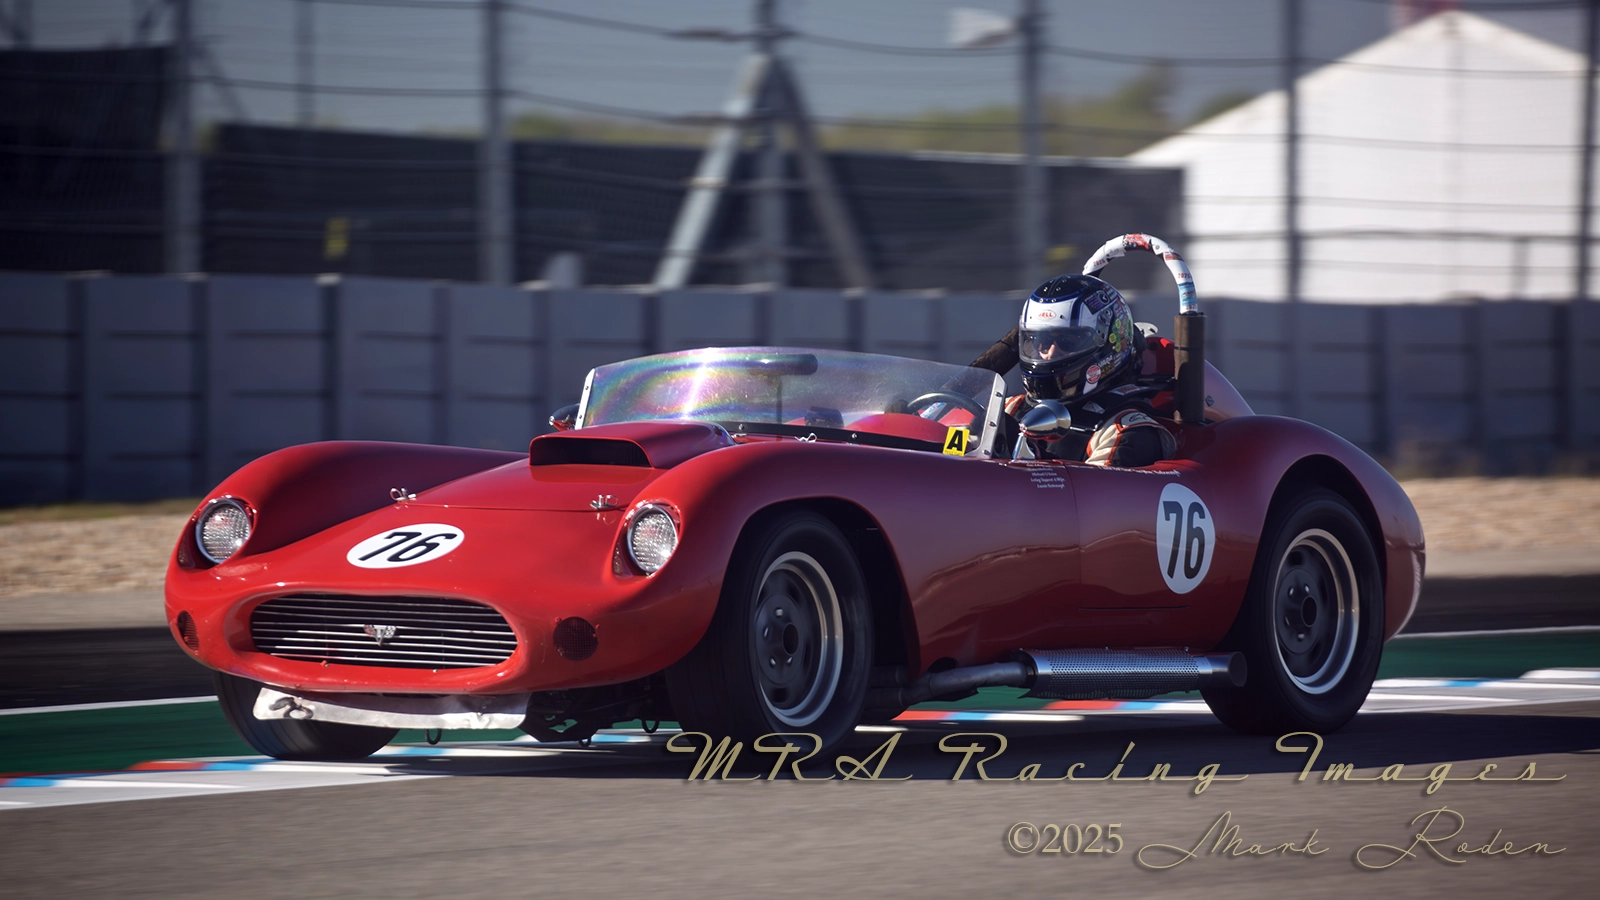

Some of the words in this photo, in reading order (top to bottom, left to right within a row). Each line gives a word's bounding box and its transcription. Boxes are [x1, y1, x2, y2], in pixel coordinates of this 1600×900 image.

[946, 429, 963, 451] A
[358, 531, 457, 562] 76
[1163, 501, 1205, 579] 76
